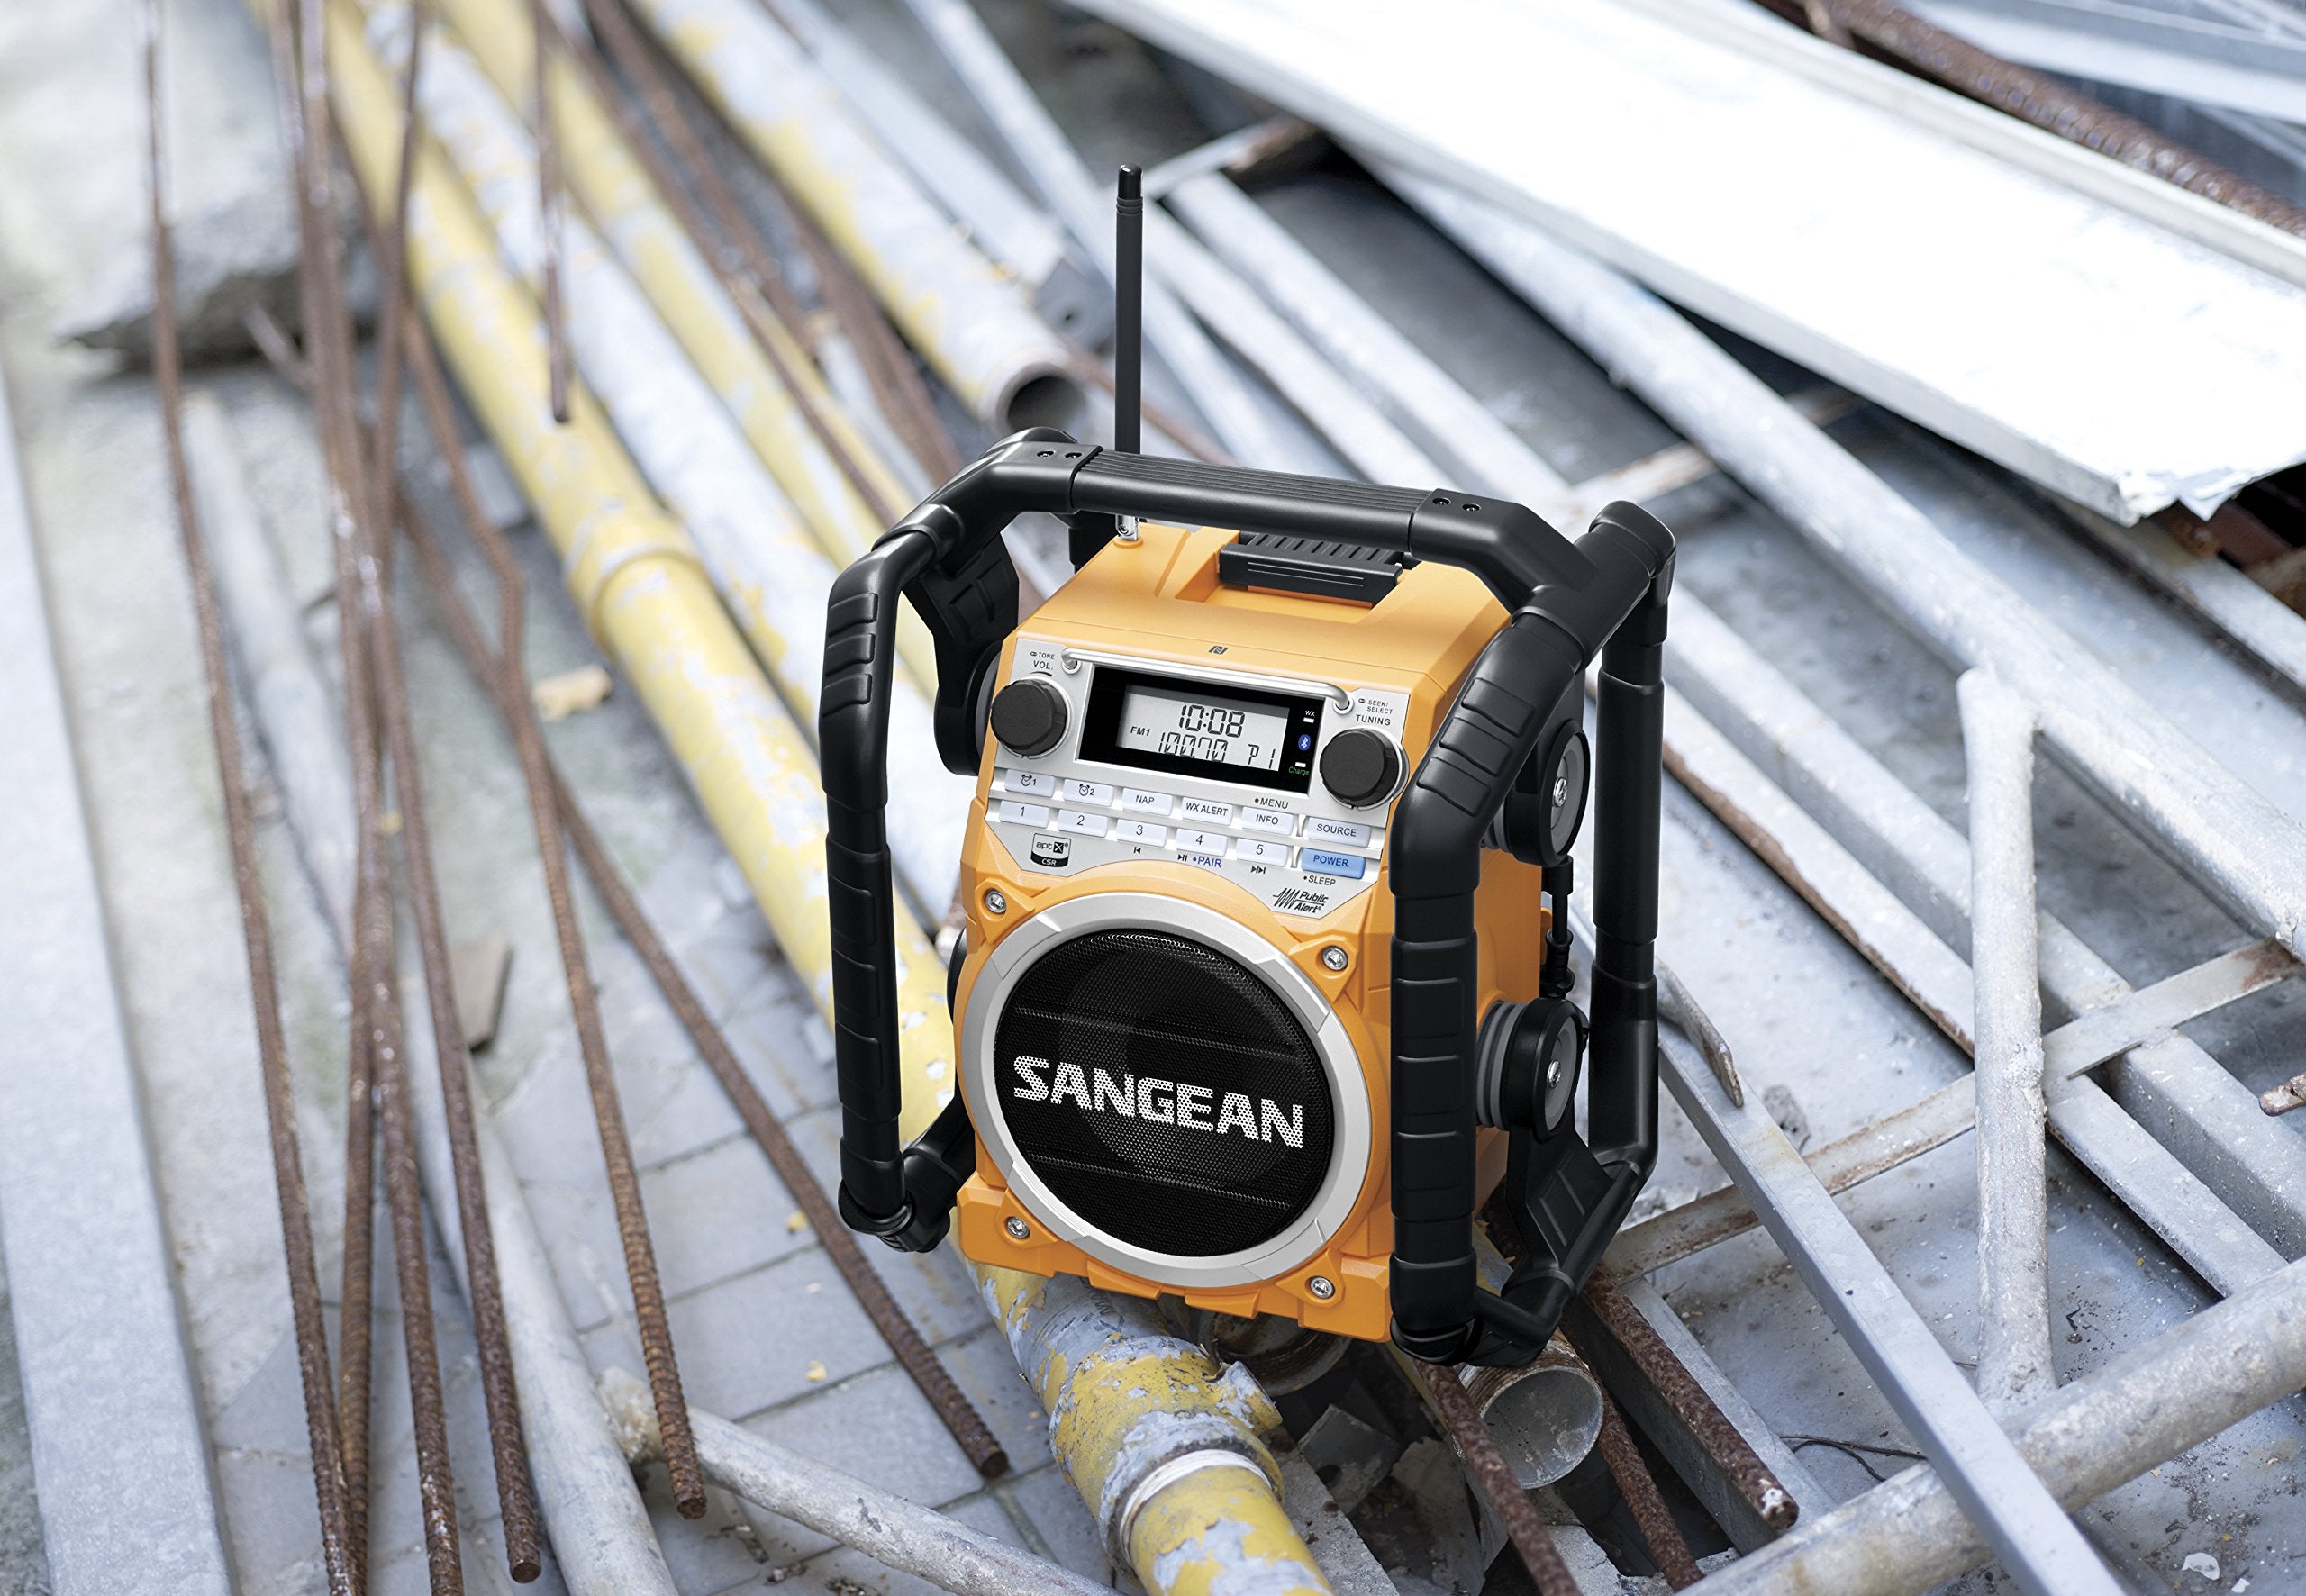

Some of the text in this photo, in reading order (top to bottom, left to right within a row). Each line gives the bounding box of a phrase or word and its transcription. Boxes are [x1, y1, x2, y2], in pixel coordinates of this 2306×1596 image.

[1038, 652, 1055, 660] TONE
[1032, 660, 1054, 670] VOL.
[1366, 706, 1394, 715] SELECT
[1178, 704, 1246, 739] 10:08
[1356, 713, 1391, 726] TUNING
[1130, 726, 1151, 737] FM1
[1288, 766, 1310, 776] Charge
[1089, 788, 1094, 796] 2
[1135, 794, 1155, 805] NAP
[1259, 797, 1289, 810] MENU
[1020, 806, 1025, 817] 1
[1185, 802, 1228, 817] WX ALERT
[1076, 815, 1085, 826] 2
[1256, 813, 1279, 825] INFO
[1135, 824, 1144, 836] 3
[1316, 823, 1357, 838] SOURCE
[1195, 834, 1203, 845] 4
[1256, 844, 1264, 856] 5
[1197, 856, 1222, 868] PAIR
[1312, 855, 1349, 868] POWER
[1308, 875, 1336, 886] SLEEP
[1299, 891, 1329, 903] Public
[1013, 1055, 1303, 1149] SANGEAN
